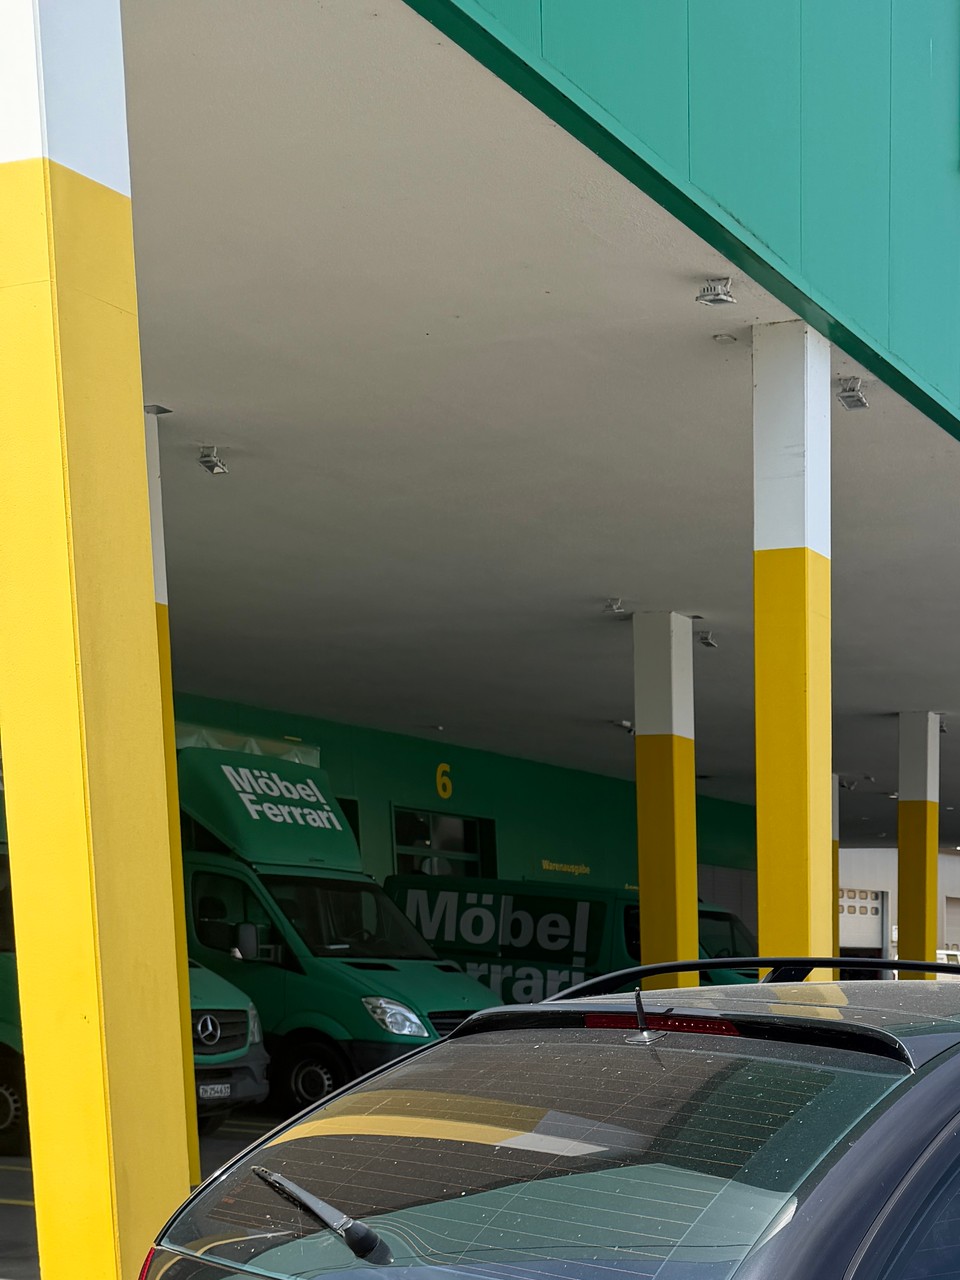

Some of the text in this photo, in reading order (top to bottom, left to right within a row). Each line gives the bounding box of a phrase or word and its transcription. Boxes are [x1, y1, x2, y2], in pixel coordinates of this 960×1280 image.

[220, 764, 327, 804] Möbel
[436, 762, 453, 799] 6
[238, 792, 343, 831] Ferrari
[406, 888, 590, 953] Möbel
[466, 957, 586, 1004] rrari
